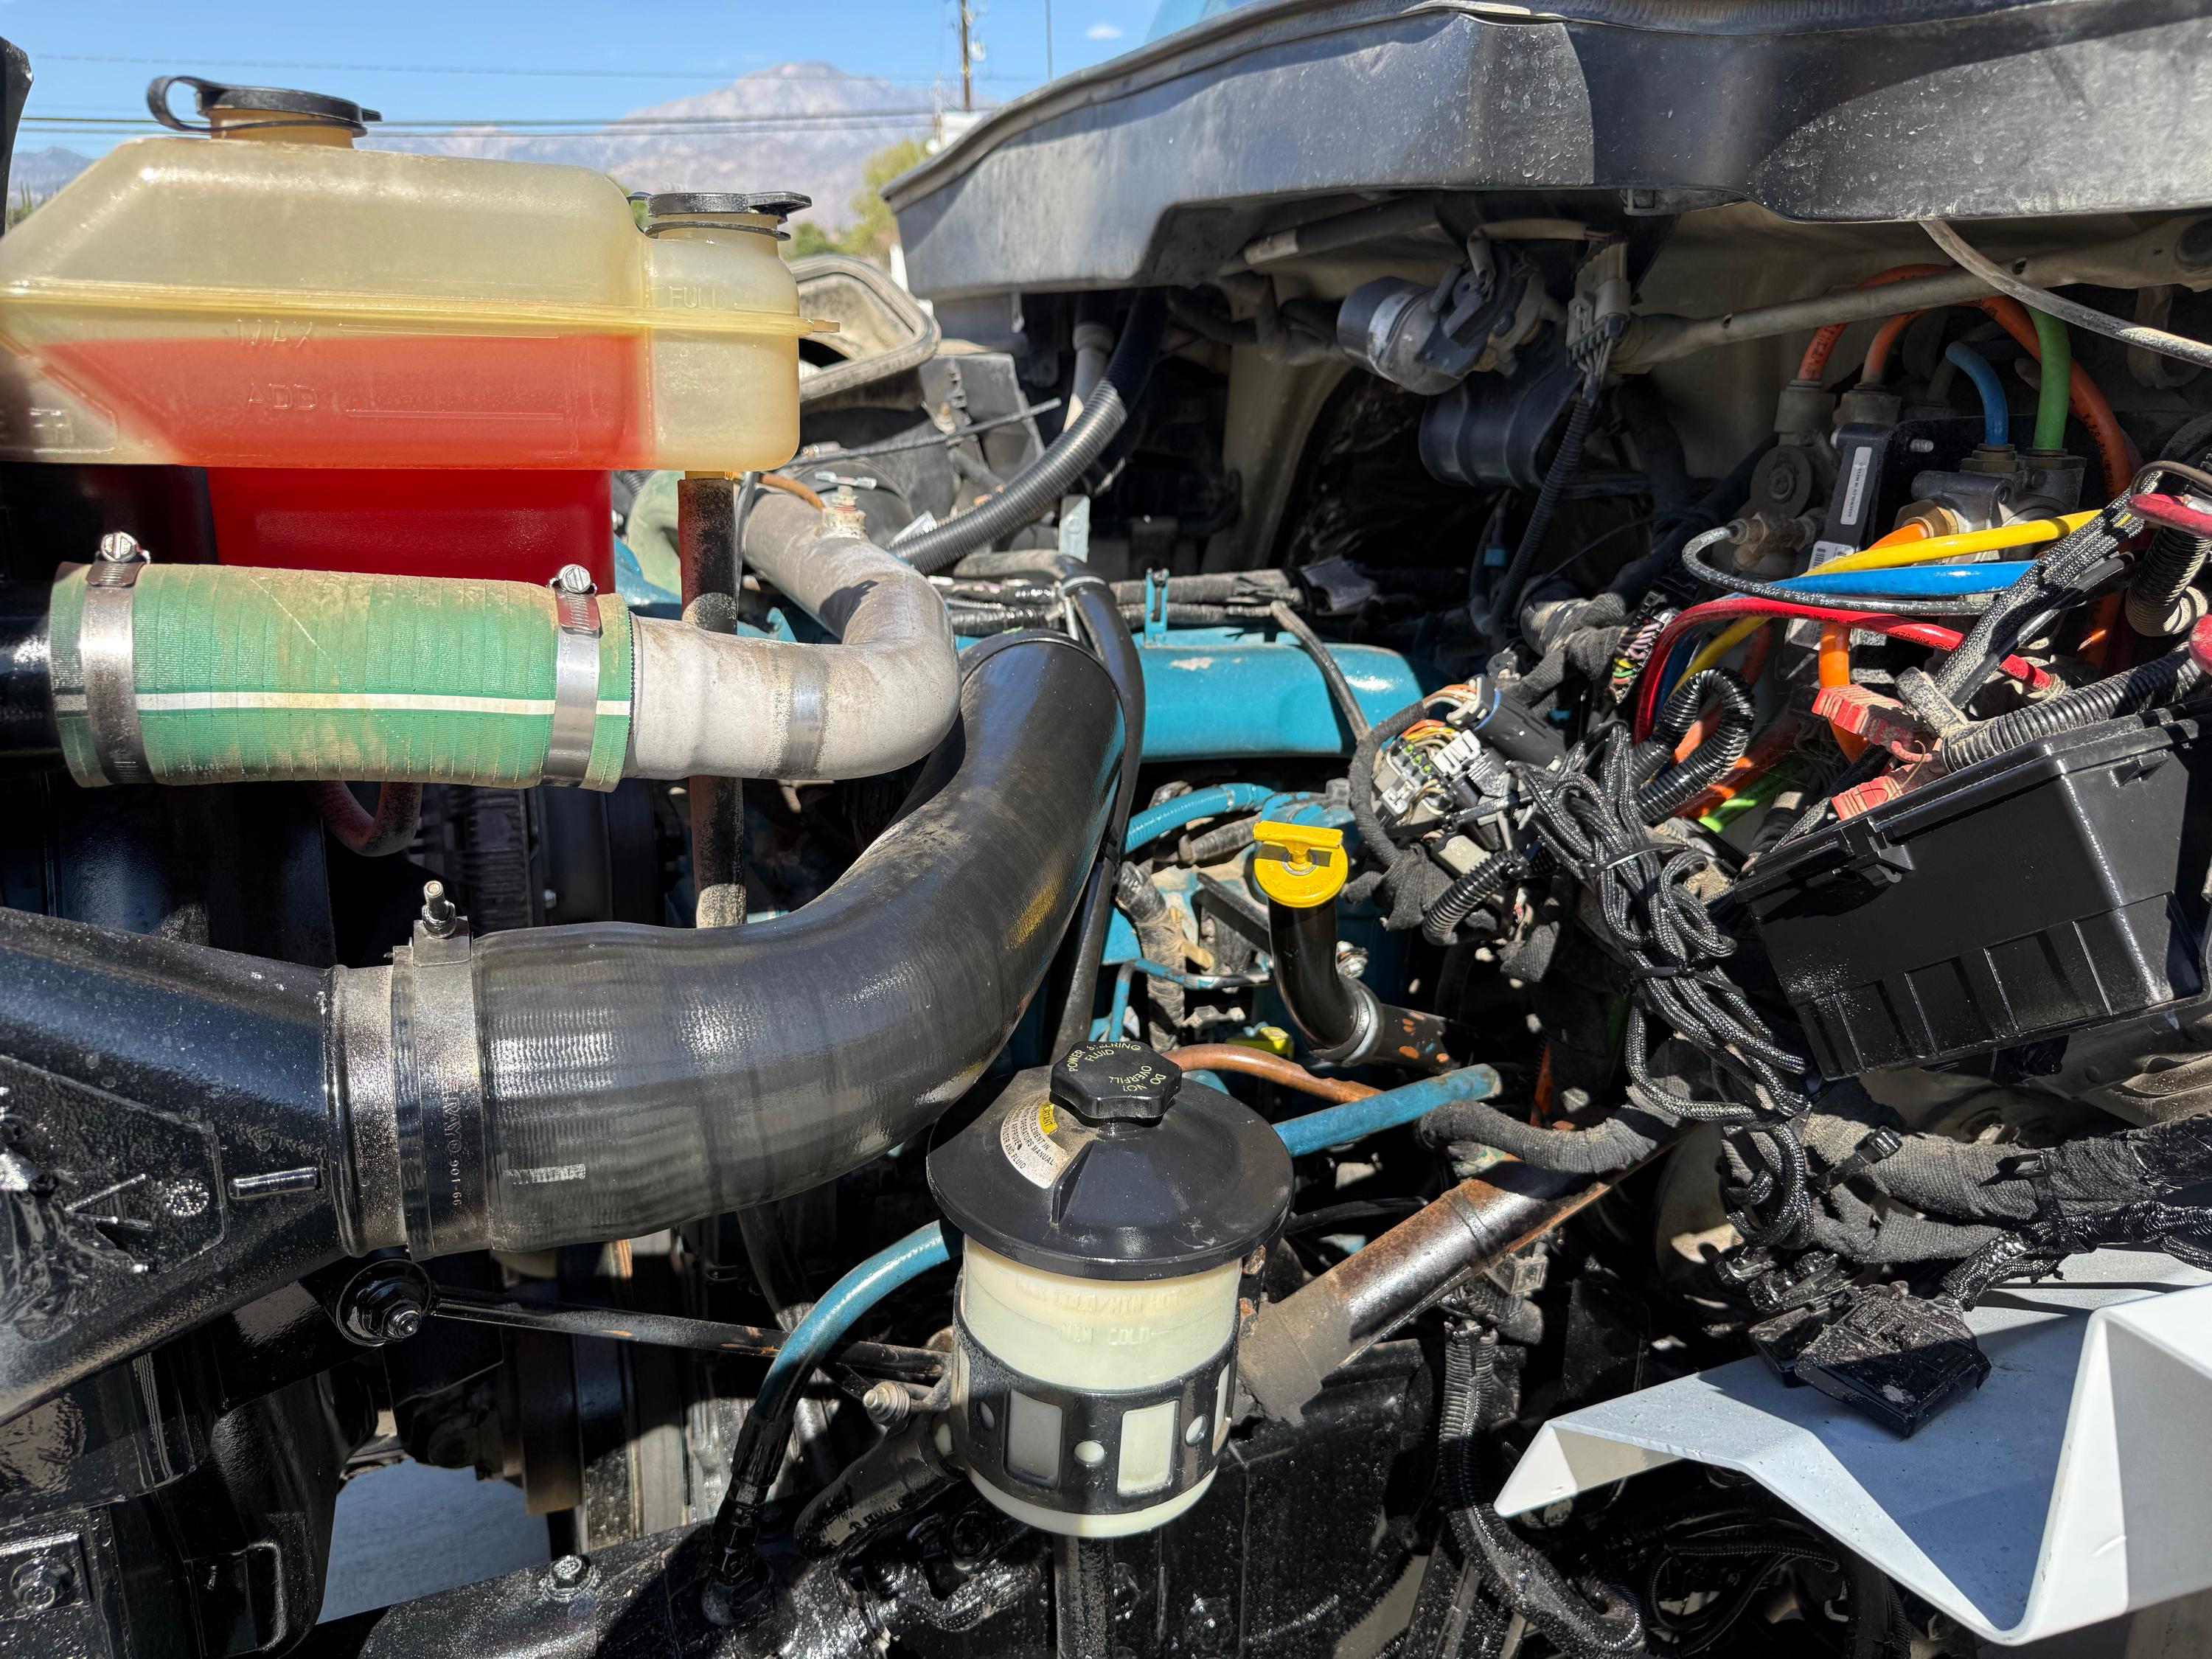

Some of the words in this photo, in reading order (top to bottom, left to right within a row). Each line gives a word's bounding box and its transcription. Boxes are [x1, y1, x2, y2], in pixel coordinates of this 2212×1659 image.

[669, 285, 726, 310] FULL
[236, 319, 316, 348] MAX
[247, 383, 318, 410] ADD
[1067, 1048, 1086, 1072] POWER
[1085, 1049, 1115, 1062] FLUID
[1109, 1065, 1152, 1084] OVERFILL
[1122, 1082, 1148, 1092] NOT
[1150, 1073, 1166, 1085] DO
[1011, 1123, 1023, 1150] APPROVE
[1020, 1116, 1034, 1147] OPERATORS
[1031, 1145, 1054, 1166] MANUAL
[1029, 1122, 1046, 1146] ELEMENT
[1041, 1141, 1051, 1151] IN
[1004, 1144, 1015, 1155] AND
[1010, 1153, 1026, 1169] FLUID
[1108, 1326, 1150, 1346] COLD
